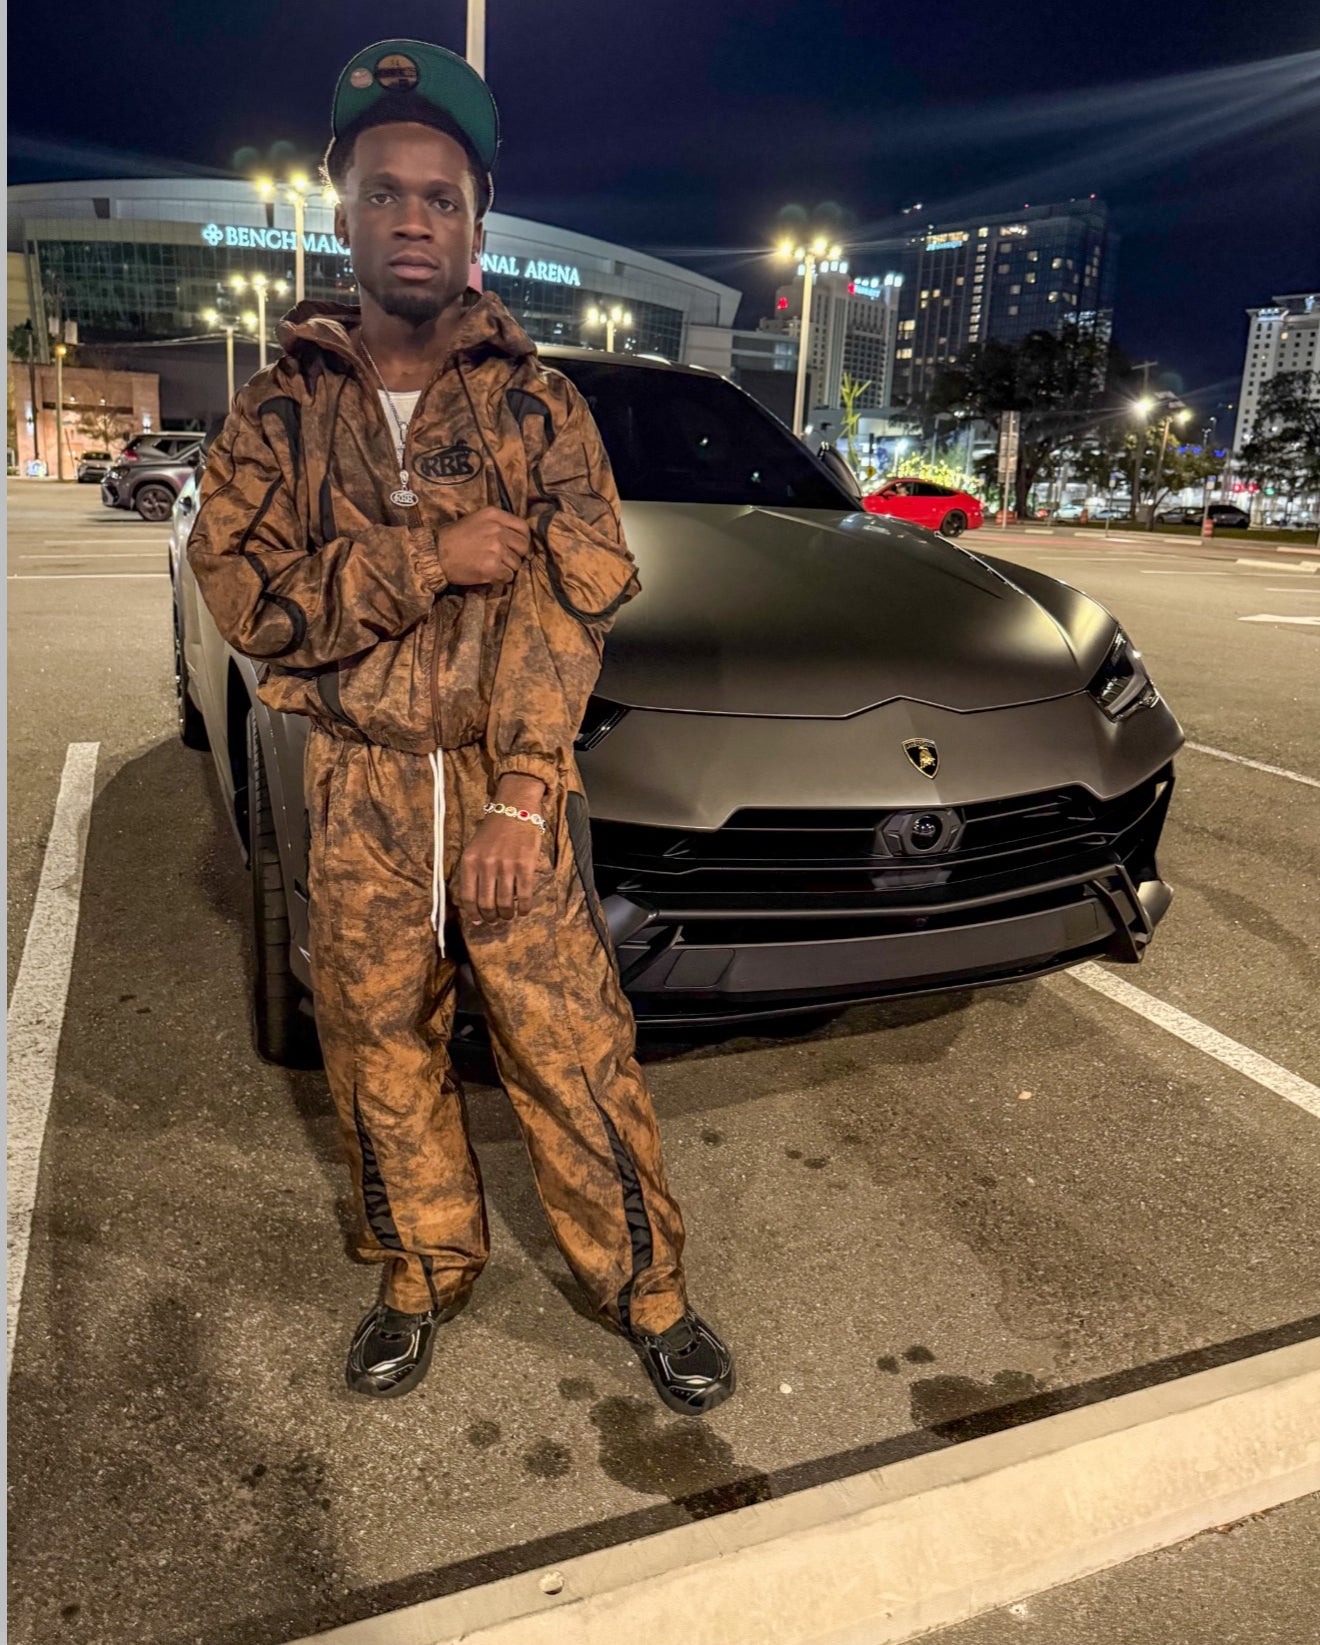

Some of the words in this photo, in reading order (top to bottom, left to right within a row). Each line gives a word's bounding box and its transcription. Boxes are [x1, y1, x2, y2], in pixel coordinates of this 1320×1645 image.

[225, 225, 351, 255] BENCHMAR
[480, 253, 519, 276] NAL
[524, 260, 581, 286] ARENA
